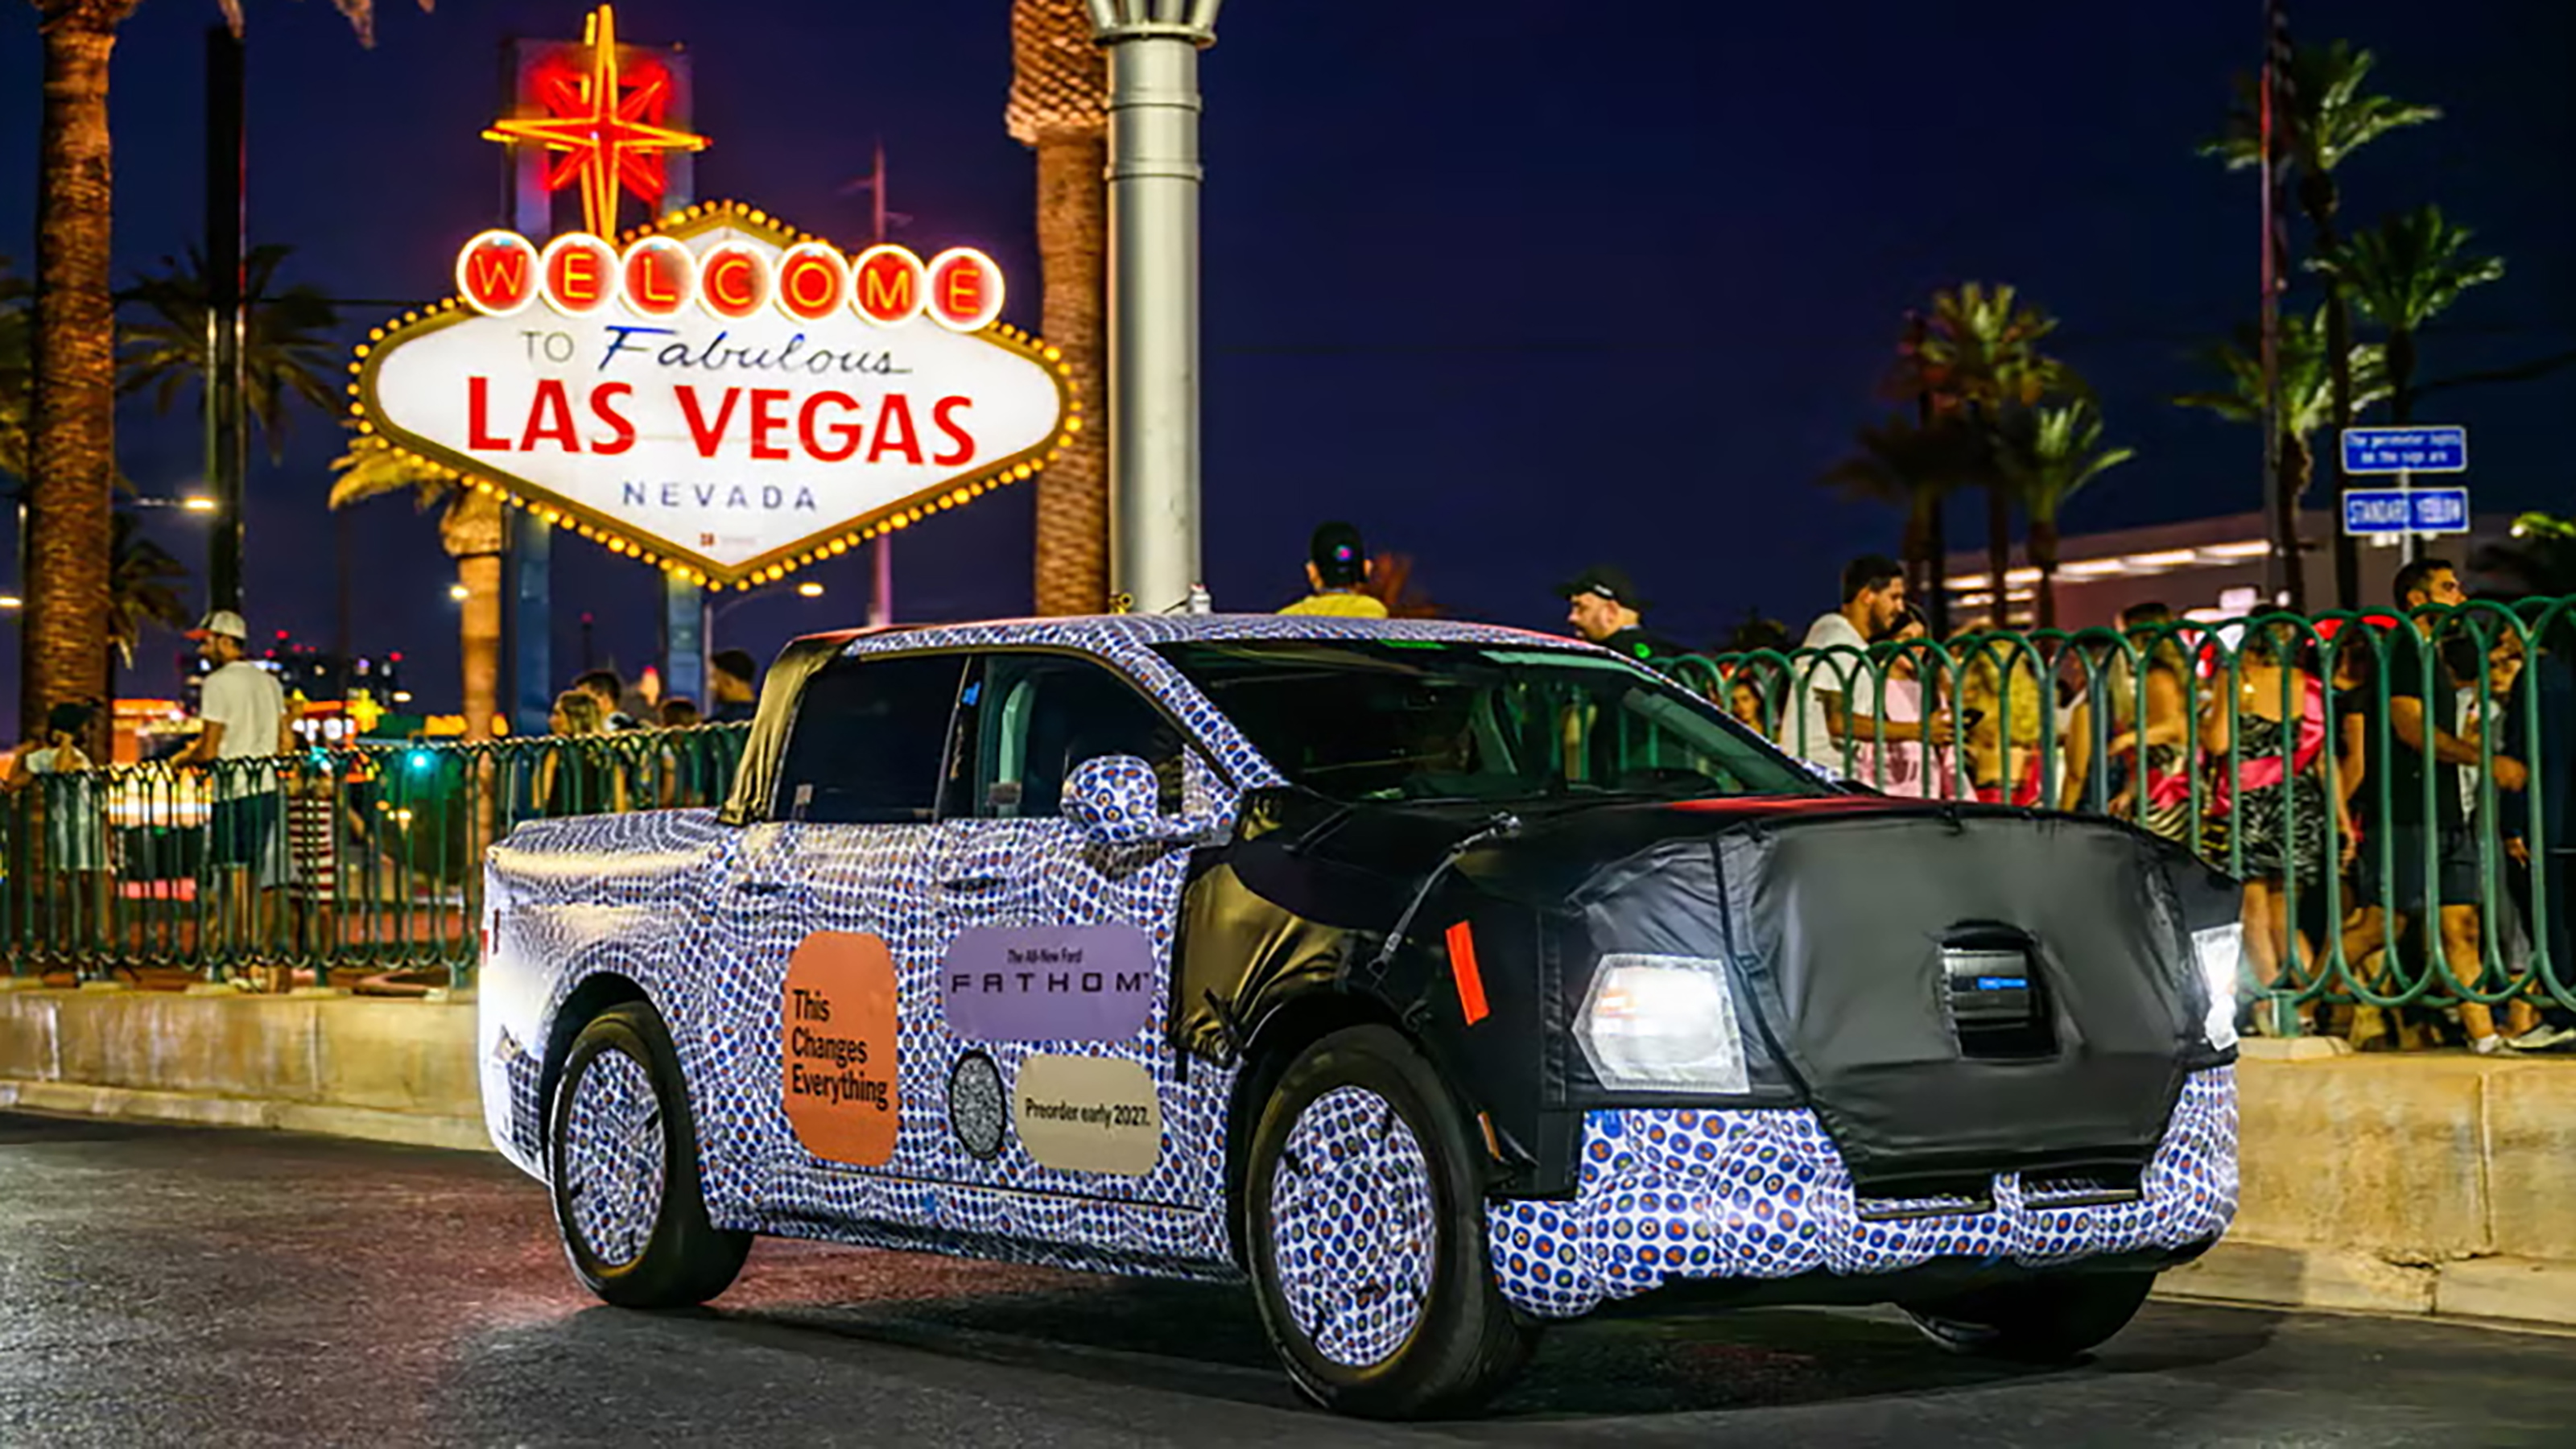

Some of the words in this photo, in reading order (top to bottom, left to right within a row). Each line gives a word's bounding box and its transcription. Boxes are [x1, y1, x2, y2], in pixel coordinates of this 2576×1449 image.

[473, 250, 980, 316] WELCOME
[521, 330, 575, 363] TO
[597, 324, 914, 375] Fabulous
[467, 375, 637, 456] LAS
[673, 383, 976, 467] VEGAS
[622, 481, 818, 511] NEVADA
[792, 989, 831, 1022] This
[792, 1026, 869, 1069] Changes
[792, 1063, 890, 1112] Everything
[1025, 1096, 1079, 1121] Preorder
[1081, 1102, 1112, 1129] early
